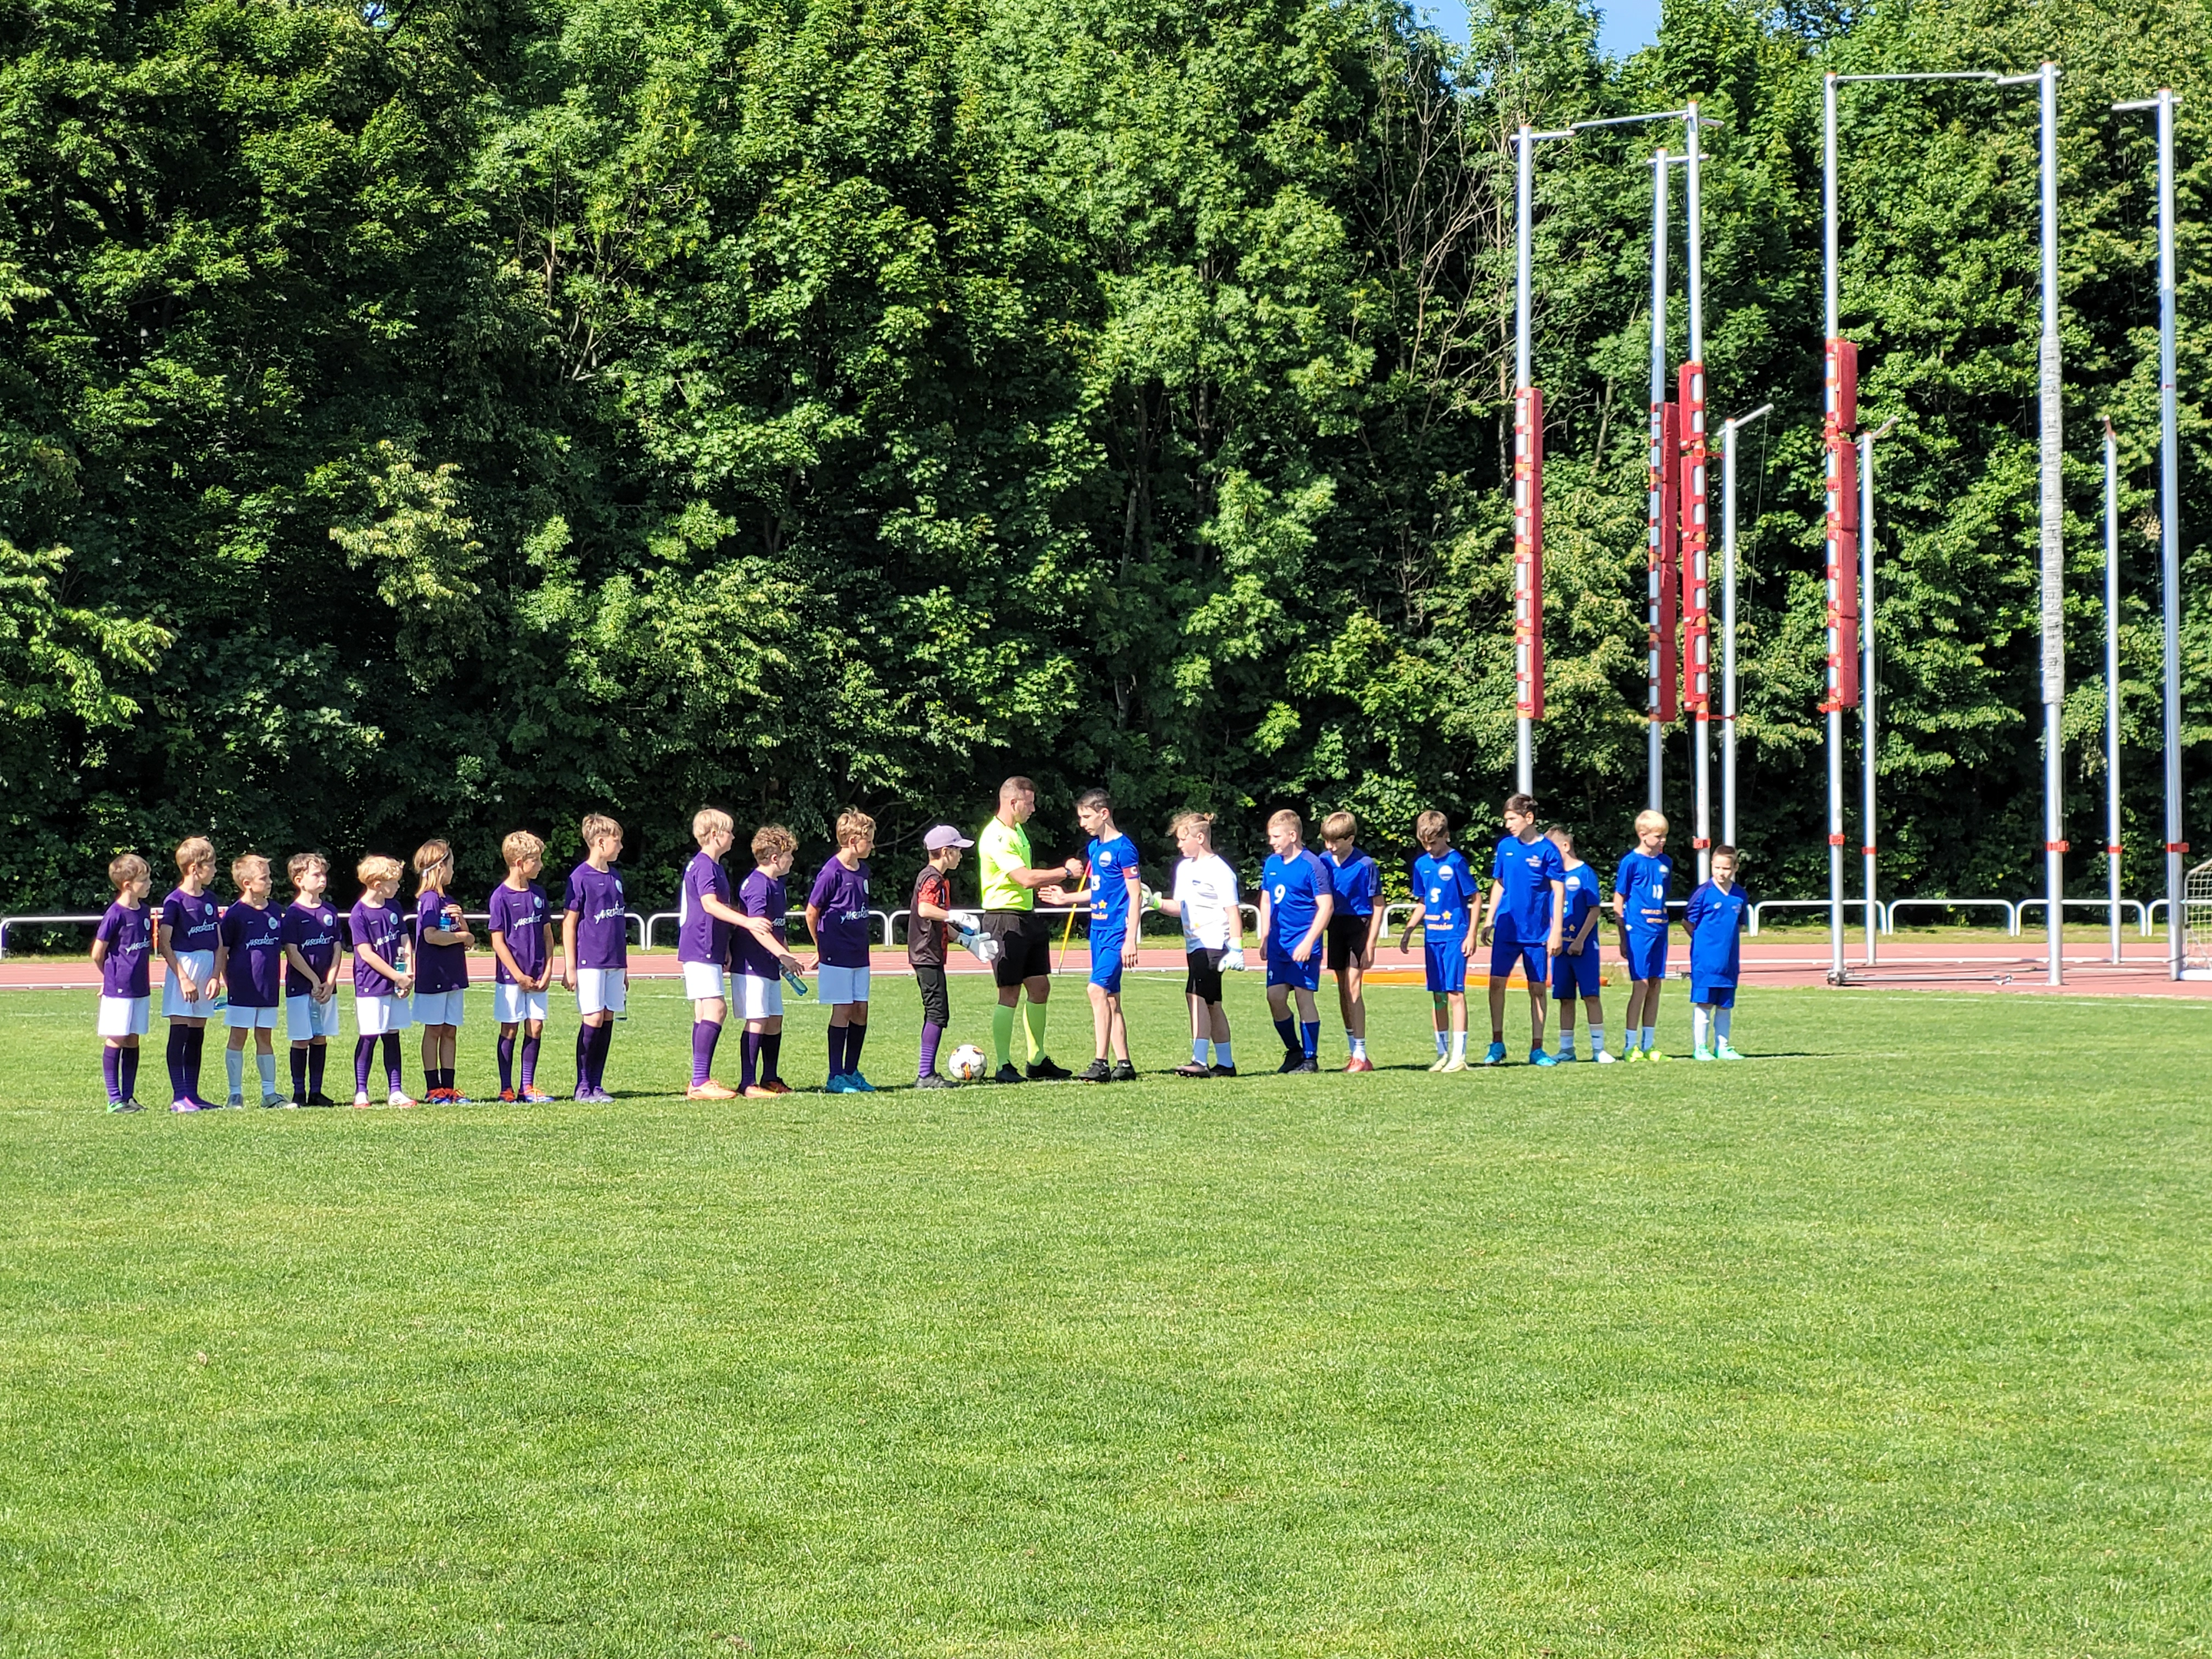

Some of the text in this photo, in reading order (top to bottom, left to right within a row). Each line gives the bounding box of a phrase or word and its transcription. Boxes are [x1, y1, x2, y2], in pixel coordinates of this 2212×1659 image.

[1130, 866, 1138, 874] C
[1274, 884, 1286, 904] 9
[1430, 887, 1441, 903] 5
